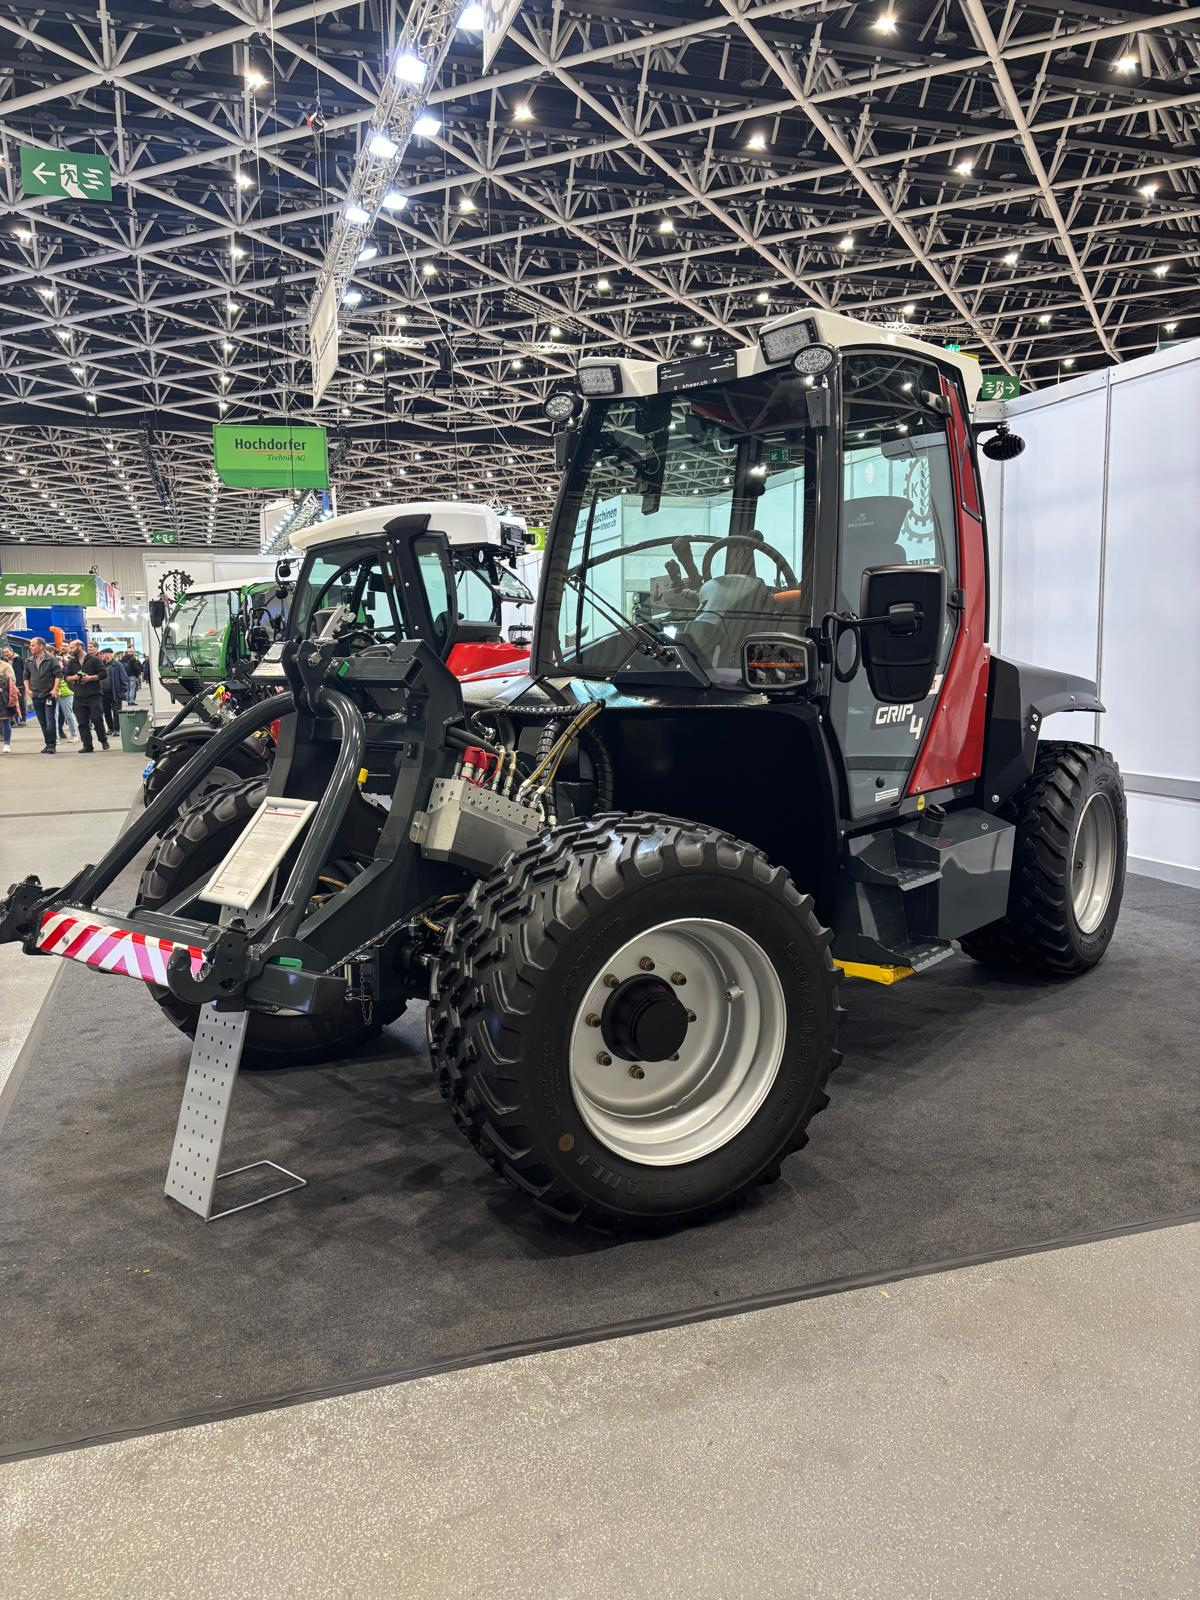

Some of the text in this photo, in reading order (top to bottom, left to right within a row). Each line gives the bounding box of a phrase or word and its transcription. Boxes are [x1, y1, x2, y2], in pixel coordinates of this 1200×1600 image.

[235, 438, 306, 450] Hochdorfer
[4, 583, 81, 597] SaMASZ
[876, 704, 923, 740] GRIP 4
